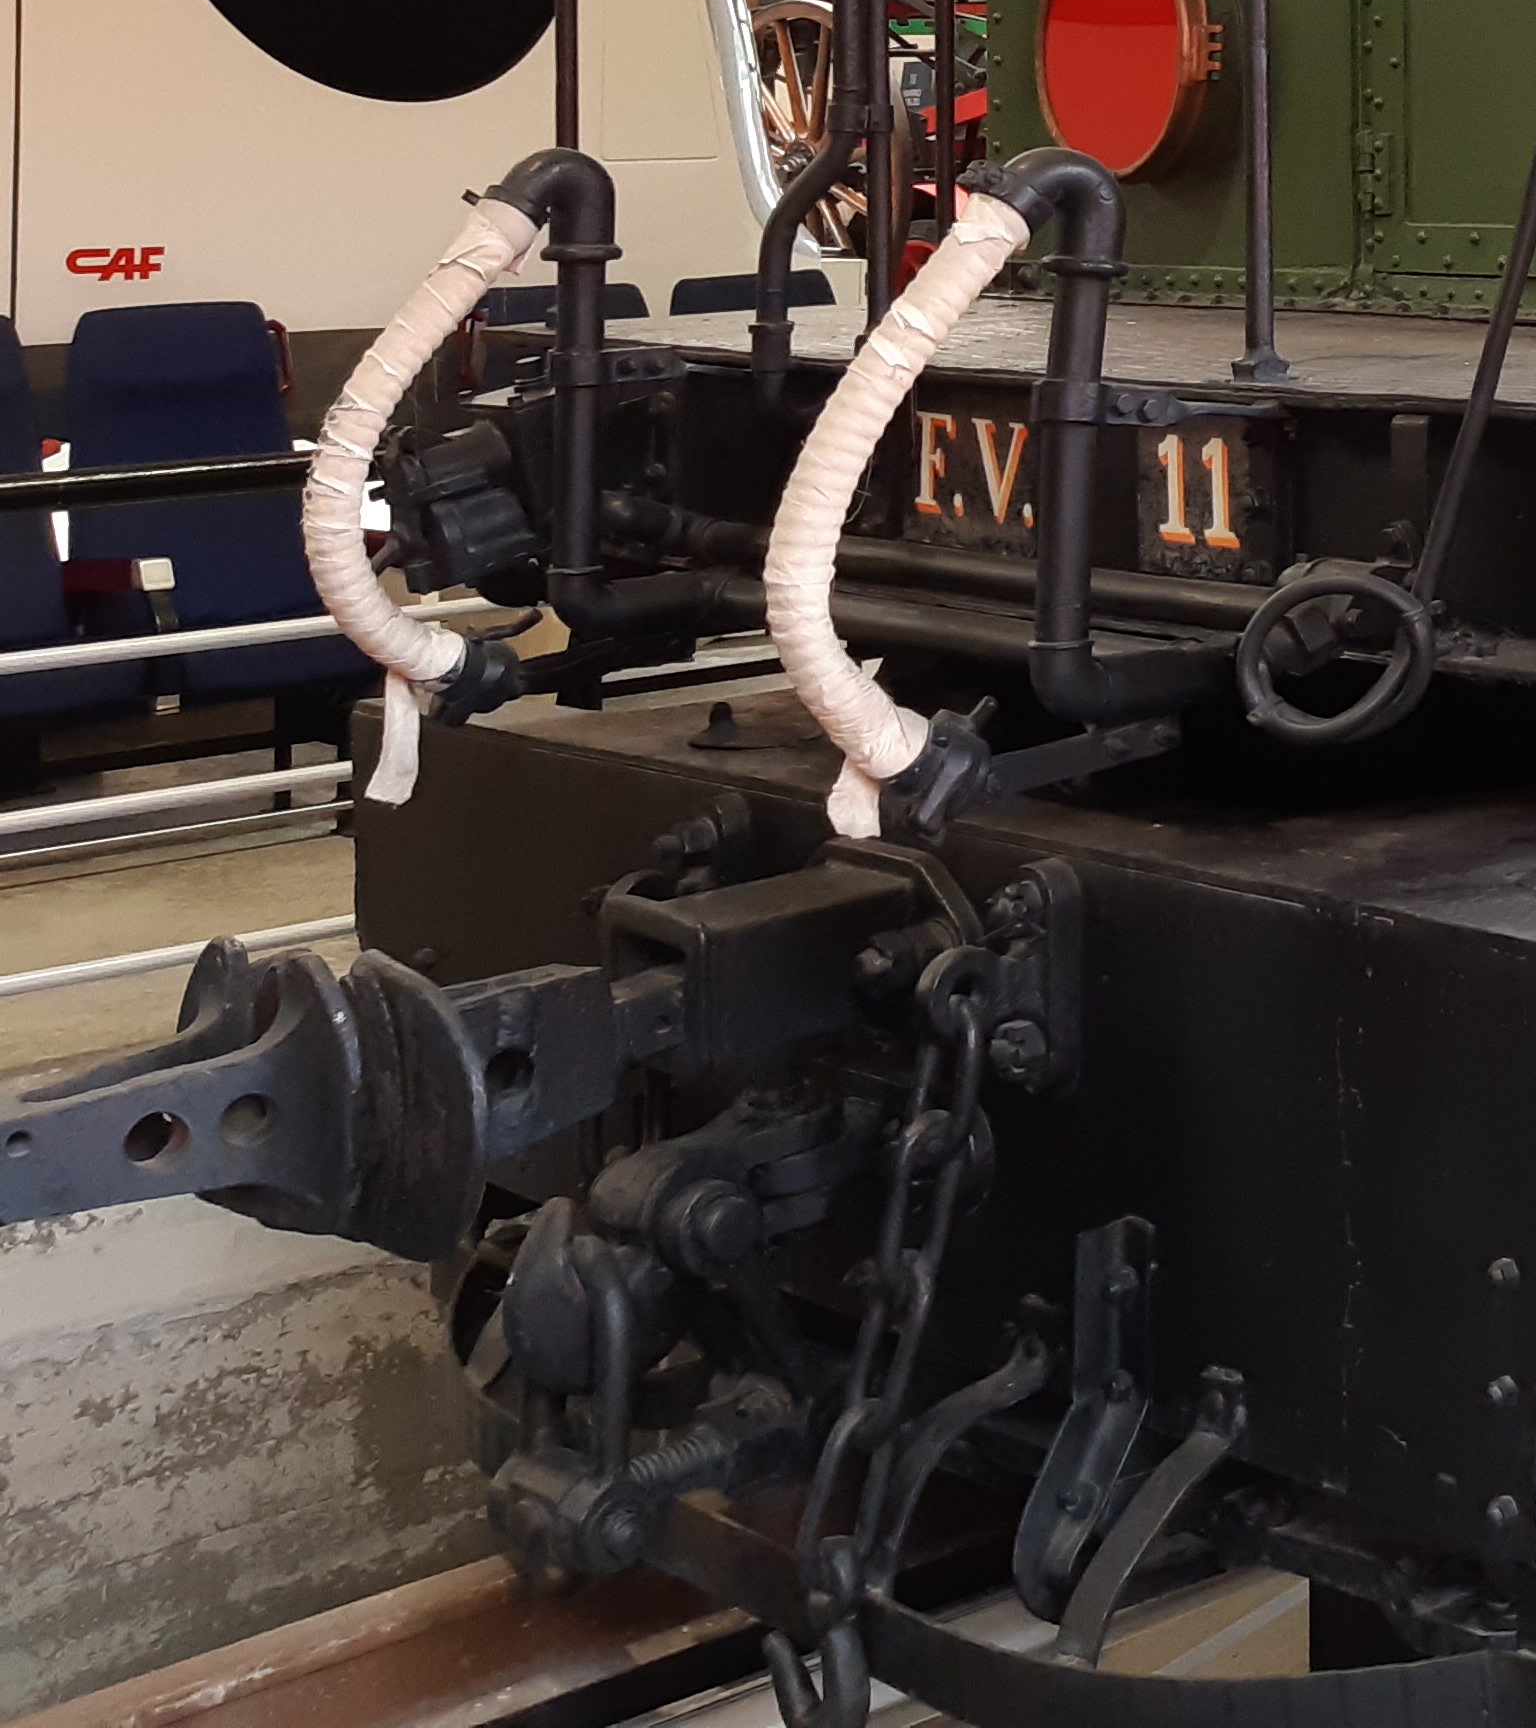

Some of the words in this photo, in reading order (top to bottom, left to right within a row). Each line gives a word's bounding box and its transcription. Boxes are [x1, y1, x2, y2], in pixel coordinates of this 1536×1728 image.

[66, 246, 165, 281] CAF
[914, 410, 1034, 529] F.V.
[1157, 434, 1241, 549] 11
